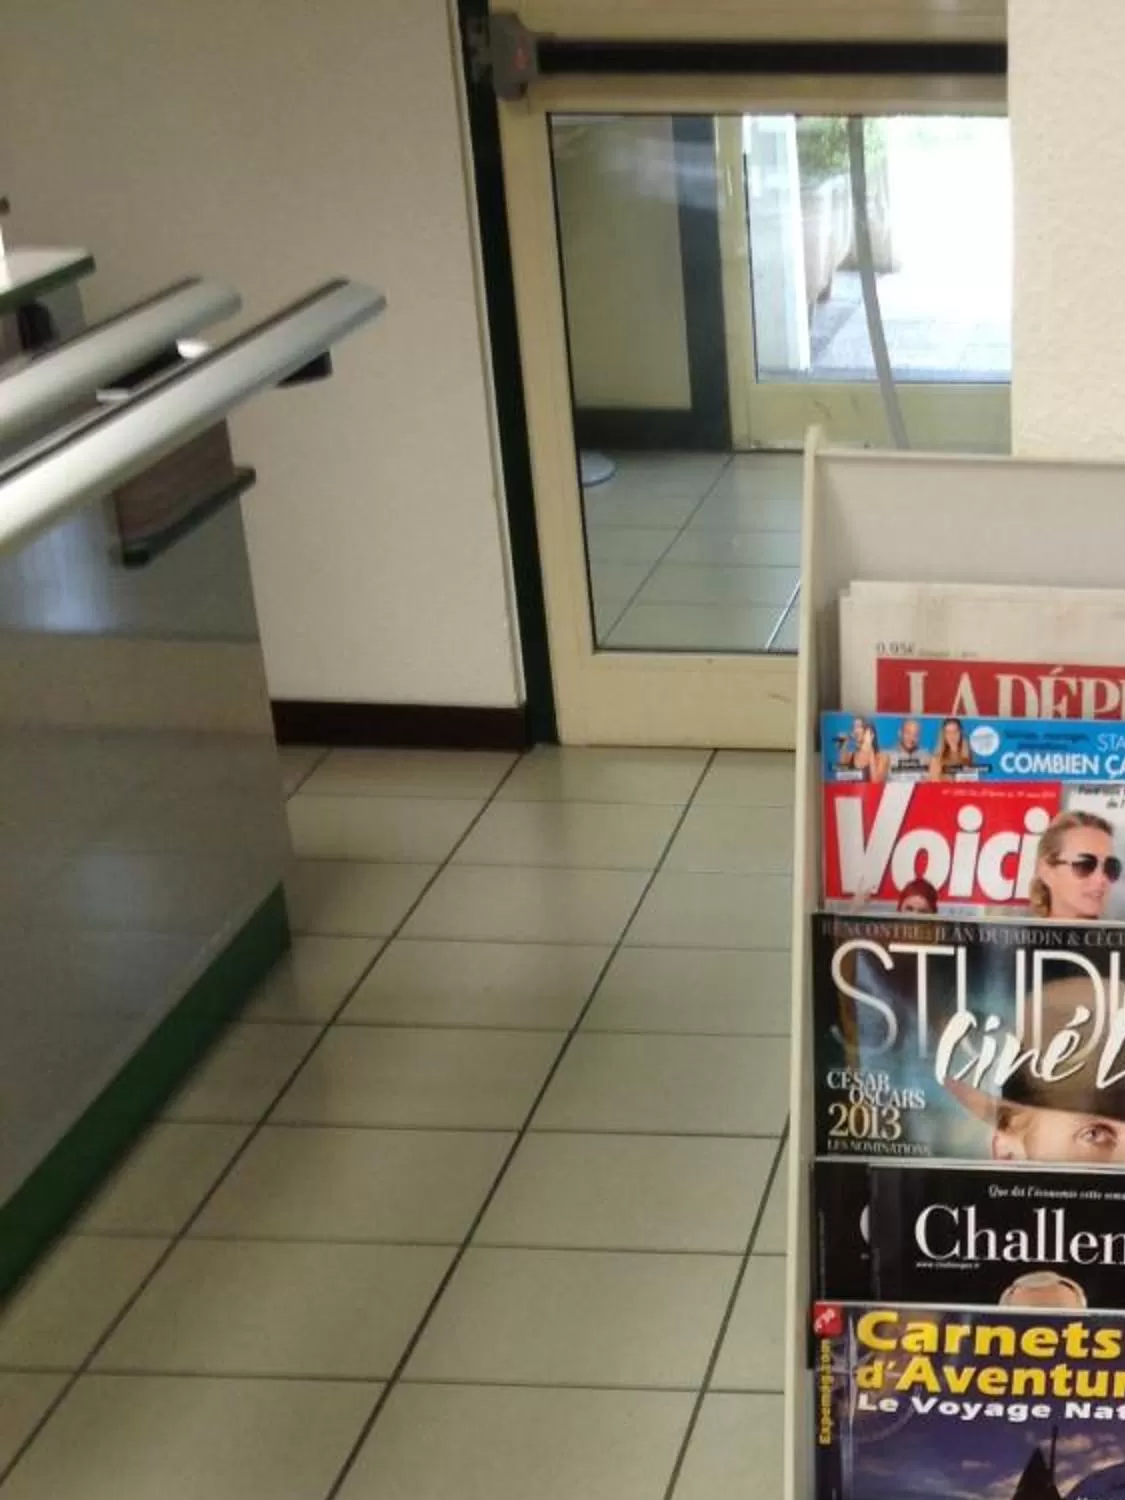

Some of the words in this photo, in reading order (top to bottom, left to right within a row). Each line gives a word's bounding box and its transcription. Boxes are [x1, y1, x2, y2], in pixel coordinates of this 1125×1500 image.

[1000, 753, 1099, 775] COMBIEN
[833, 781, 1050, 900] Voici
[848, 1087, 926, 1109] OSCARS
[828, 1103, 902, 1141] 2013
[857, 1310, 1122, 1360] Carnets
[857, 1393, 898, 1413] Le
[911, 1396, 1052, 1423] Voyage
